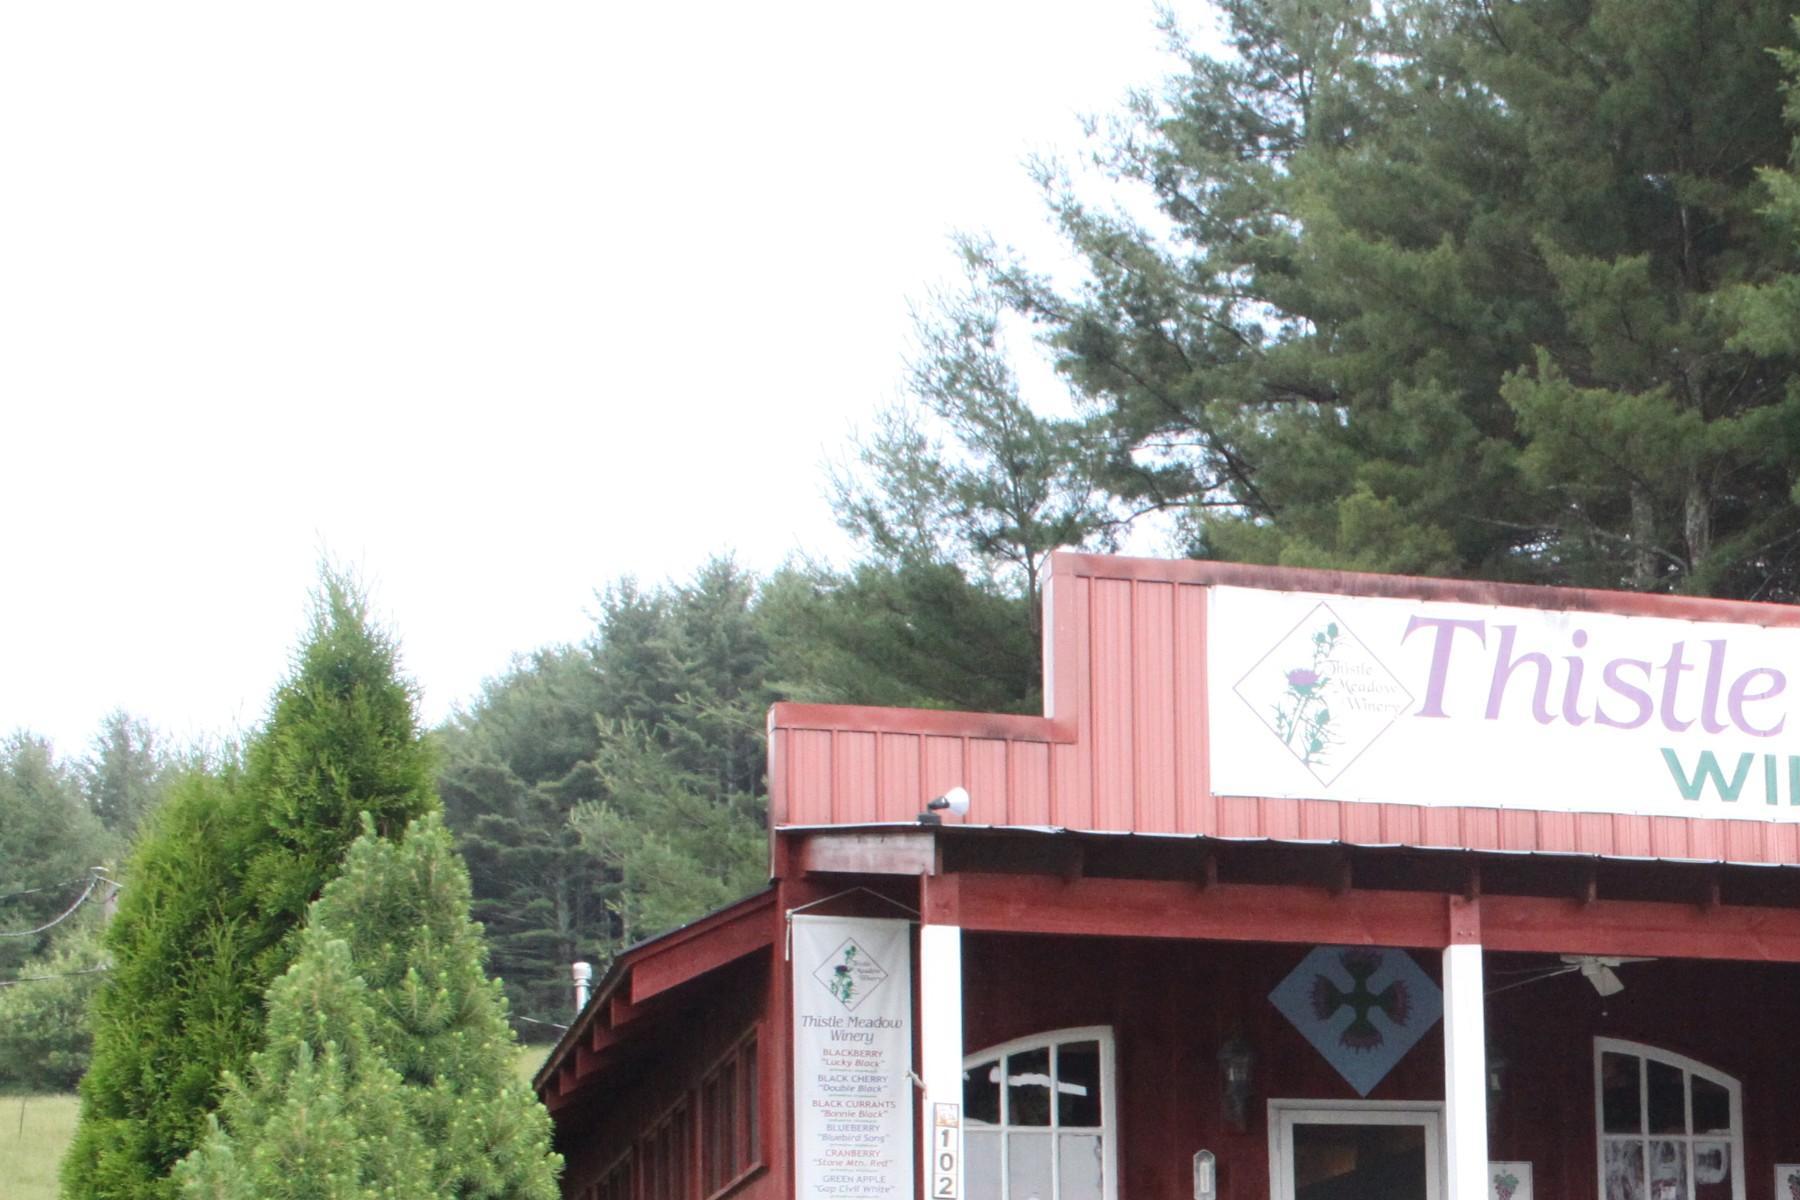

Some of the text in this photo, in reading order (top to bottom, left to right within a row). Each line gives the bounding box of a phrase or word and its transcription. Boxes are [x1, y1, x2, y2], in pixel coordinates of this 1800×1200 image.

[1400, 614, 1787, 737] Thistle
[802, 1015, 903, 1029] Thistle Meadow
[830, 1030, 874, 1045] Winery
[823, 1048, 883, 1058] BLACKBERRY
[817, 1074, 889, 1083] BLACK CHERRY
[812, 1099, 897, 1109] BLACK CURRANTS
[826, 1123, 880, 1132] BLUEBERRY
[825, 1149, 881, 1157] CRANBERRY
[822, 1175, 887, 1184] GREEN APPLE
